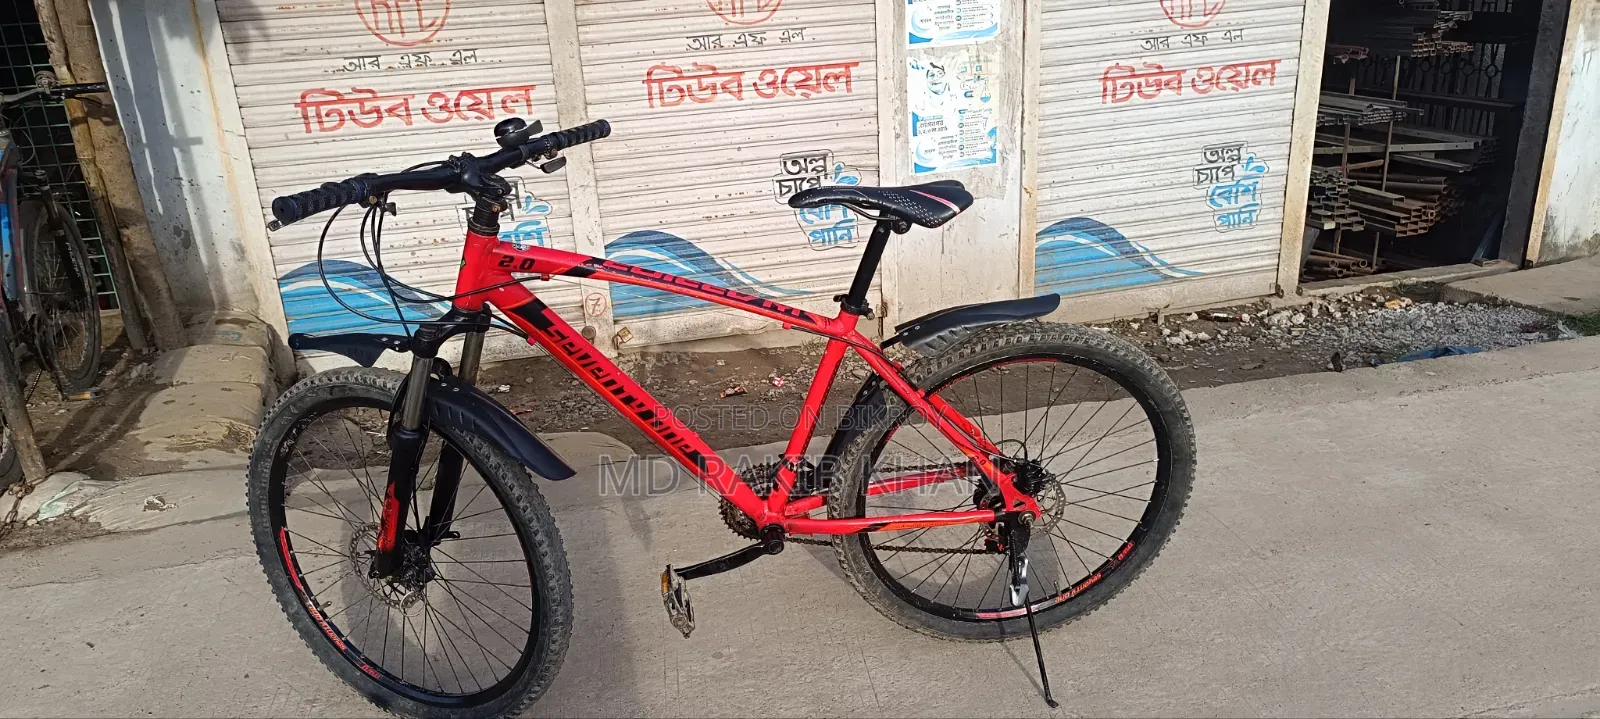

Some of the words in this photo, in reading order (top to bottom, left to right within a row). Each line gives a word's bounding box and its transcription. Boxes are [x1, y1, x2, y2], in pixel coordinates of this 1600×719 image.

[686, 33, 723, 51] আর
[1140, 35, 1172, 51] আর
[342, 54, 382, 72] আর
[642, 61, 746, 109] টিউব
[752, 61, 861, 99] ওয়েল
[1098, 61, 1187, 105] টিউব
[1190, 58, 1282, 95] ওয়েল
[294, 86, 417, 134] টিউব
[420, 84, 538, 124] ওয়েল
[782, 152, 829, 176] অল্প
[1203, 143, 1245, 164] অল্প
[1194, 163, 1238, 185] চাপে
[1216, 202, 1260, 229] পানি
[808, 217, 856, 246] পানি
[498, 254, 537, 271] 2.0
